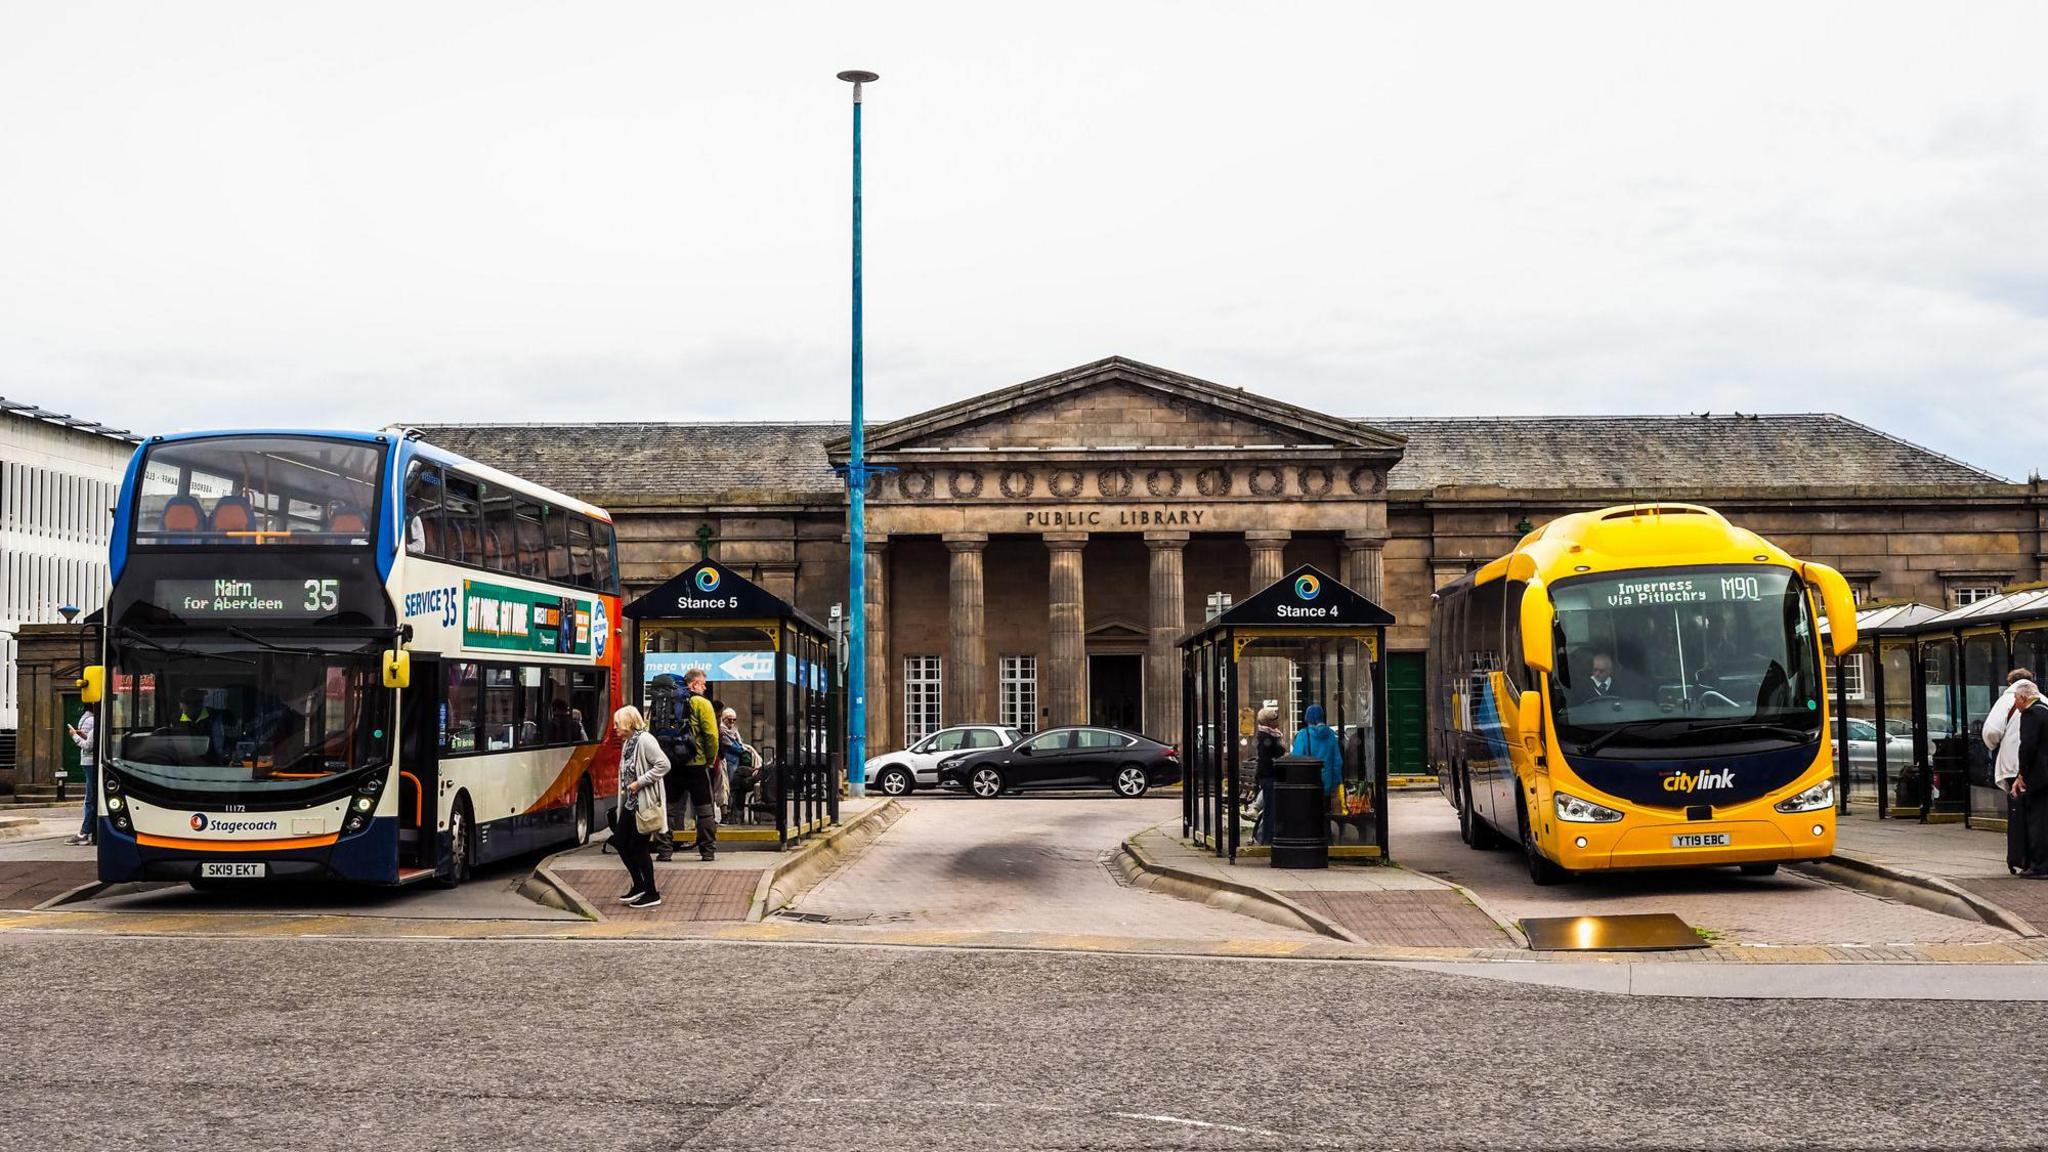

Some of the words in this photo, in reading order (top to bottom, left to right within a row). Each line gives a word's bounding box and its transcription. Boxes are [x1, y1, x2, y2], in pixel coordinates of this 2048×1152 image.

[1026, 511, 1100, 526] PUBLIC
[1120, 510, 1204, 526] LIBRARY
[214, 579, 252, 597] Nairn
[303, 579, 338, 611] 35
[1618, 581, 1692, 595] Inverness
[184, 597, 209, 609] for
[213, 597, 283, 611] Aberdeen
[678, 597, 726, 609] Stance
[729, 597, 738, 608] 5
[1608, 594, 1632, 606] Via
[1638, 590, 1706, 604] Pitlochry
[405, 589, 441, 617] SERVICE
[442, 587, 457, 627] 35
[1277, 604, 1326, 617] Stance
[1329, 605, 1339, 617] 4
[646, 663, 677, 673] mega
[680, 660, 712, 671] value
[1663, 768, 1736, 793] citylink
[210, 820, 277, 833] Stagecoach
[1677, 835, 1701, 846] YT19
[1703, 834, 1725, 846] EBC
[208, 865, 233, 876] SK19
[235, 865, 258, 875] EKT
